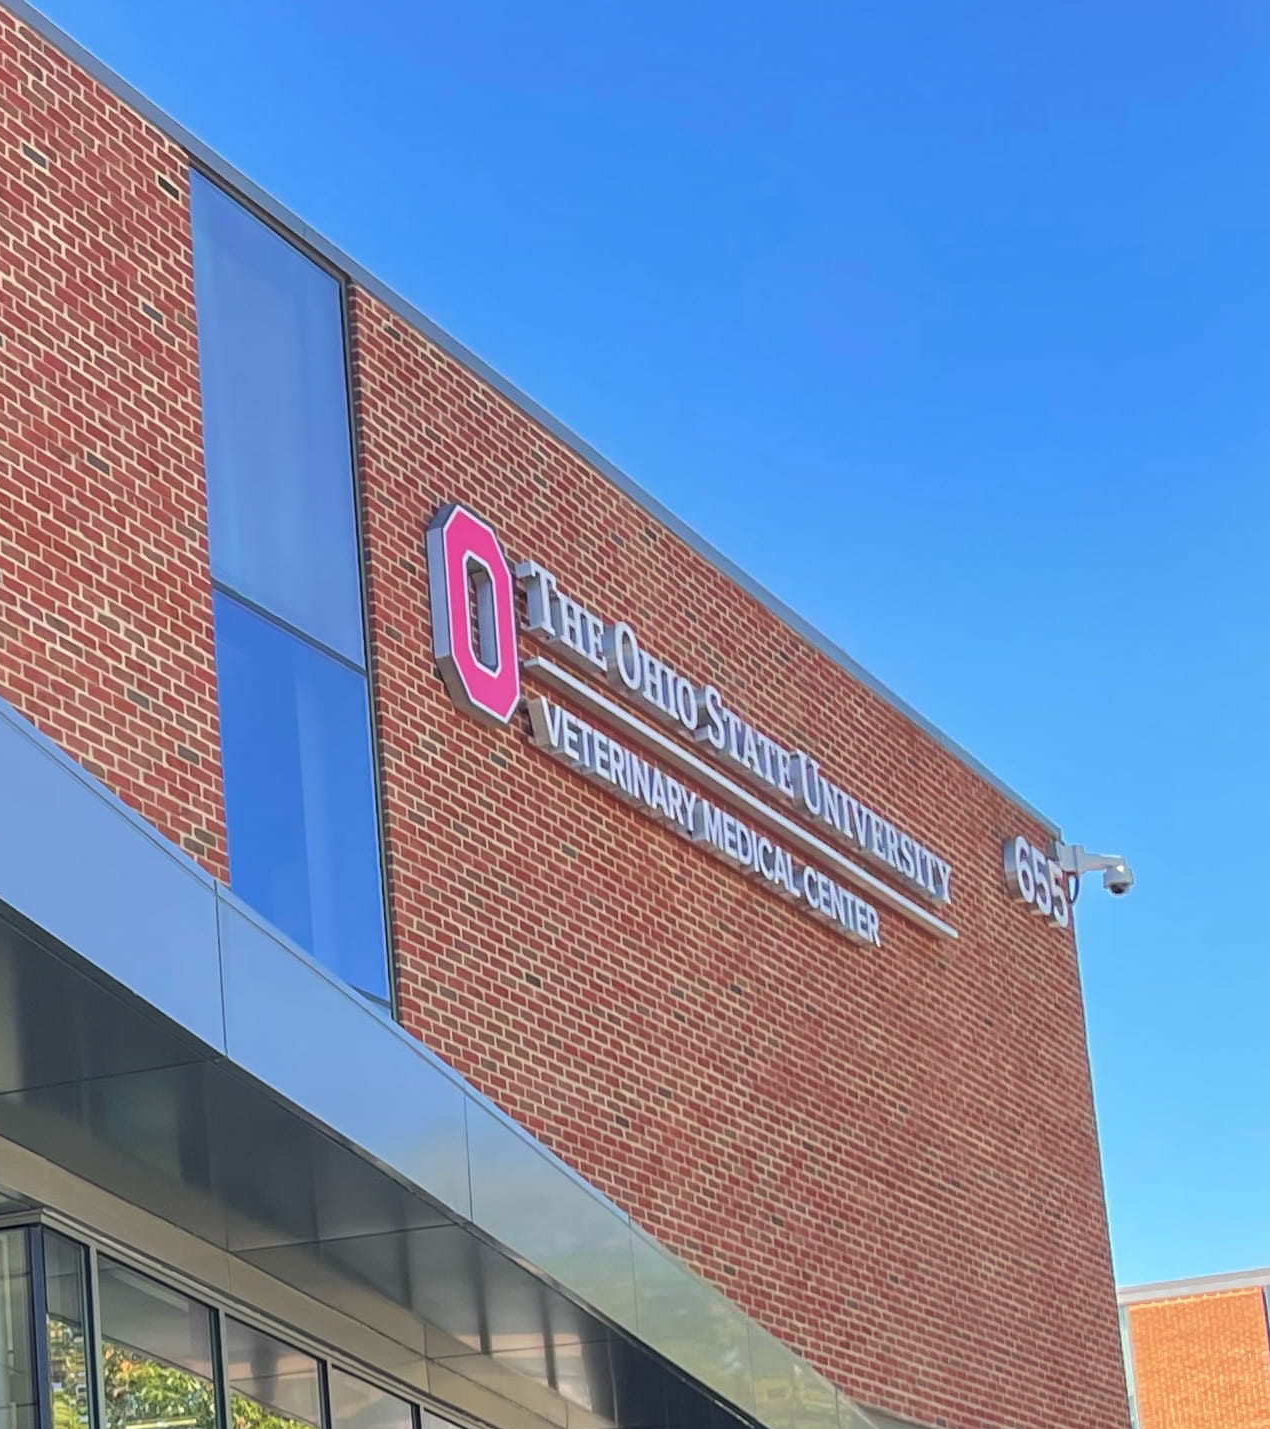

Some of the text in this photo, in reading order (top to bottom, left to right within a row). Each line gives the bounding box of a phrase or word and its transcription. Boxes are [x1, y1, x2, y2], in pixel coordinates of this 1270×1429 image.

[517, 559, 953, 905] THE OHIO STATE UNIVERSITY
[528, 695, 882, 948] VETERINARY MEDICAL CENTER
[1005, 835, 1070, 929] 655
